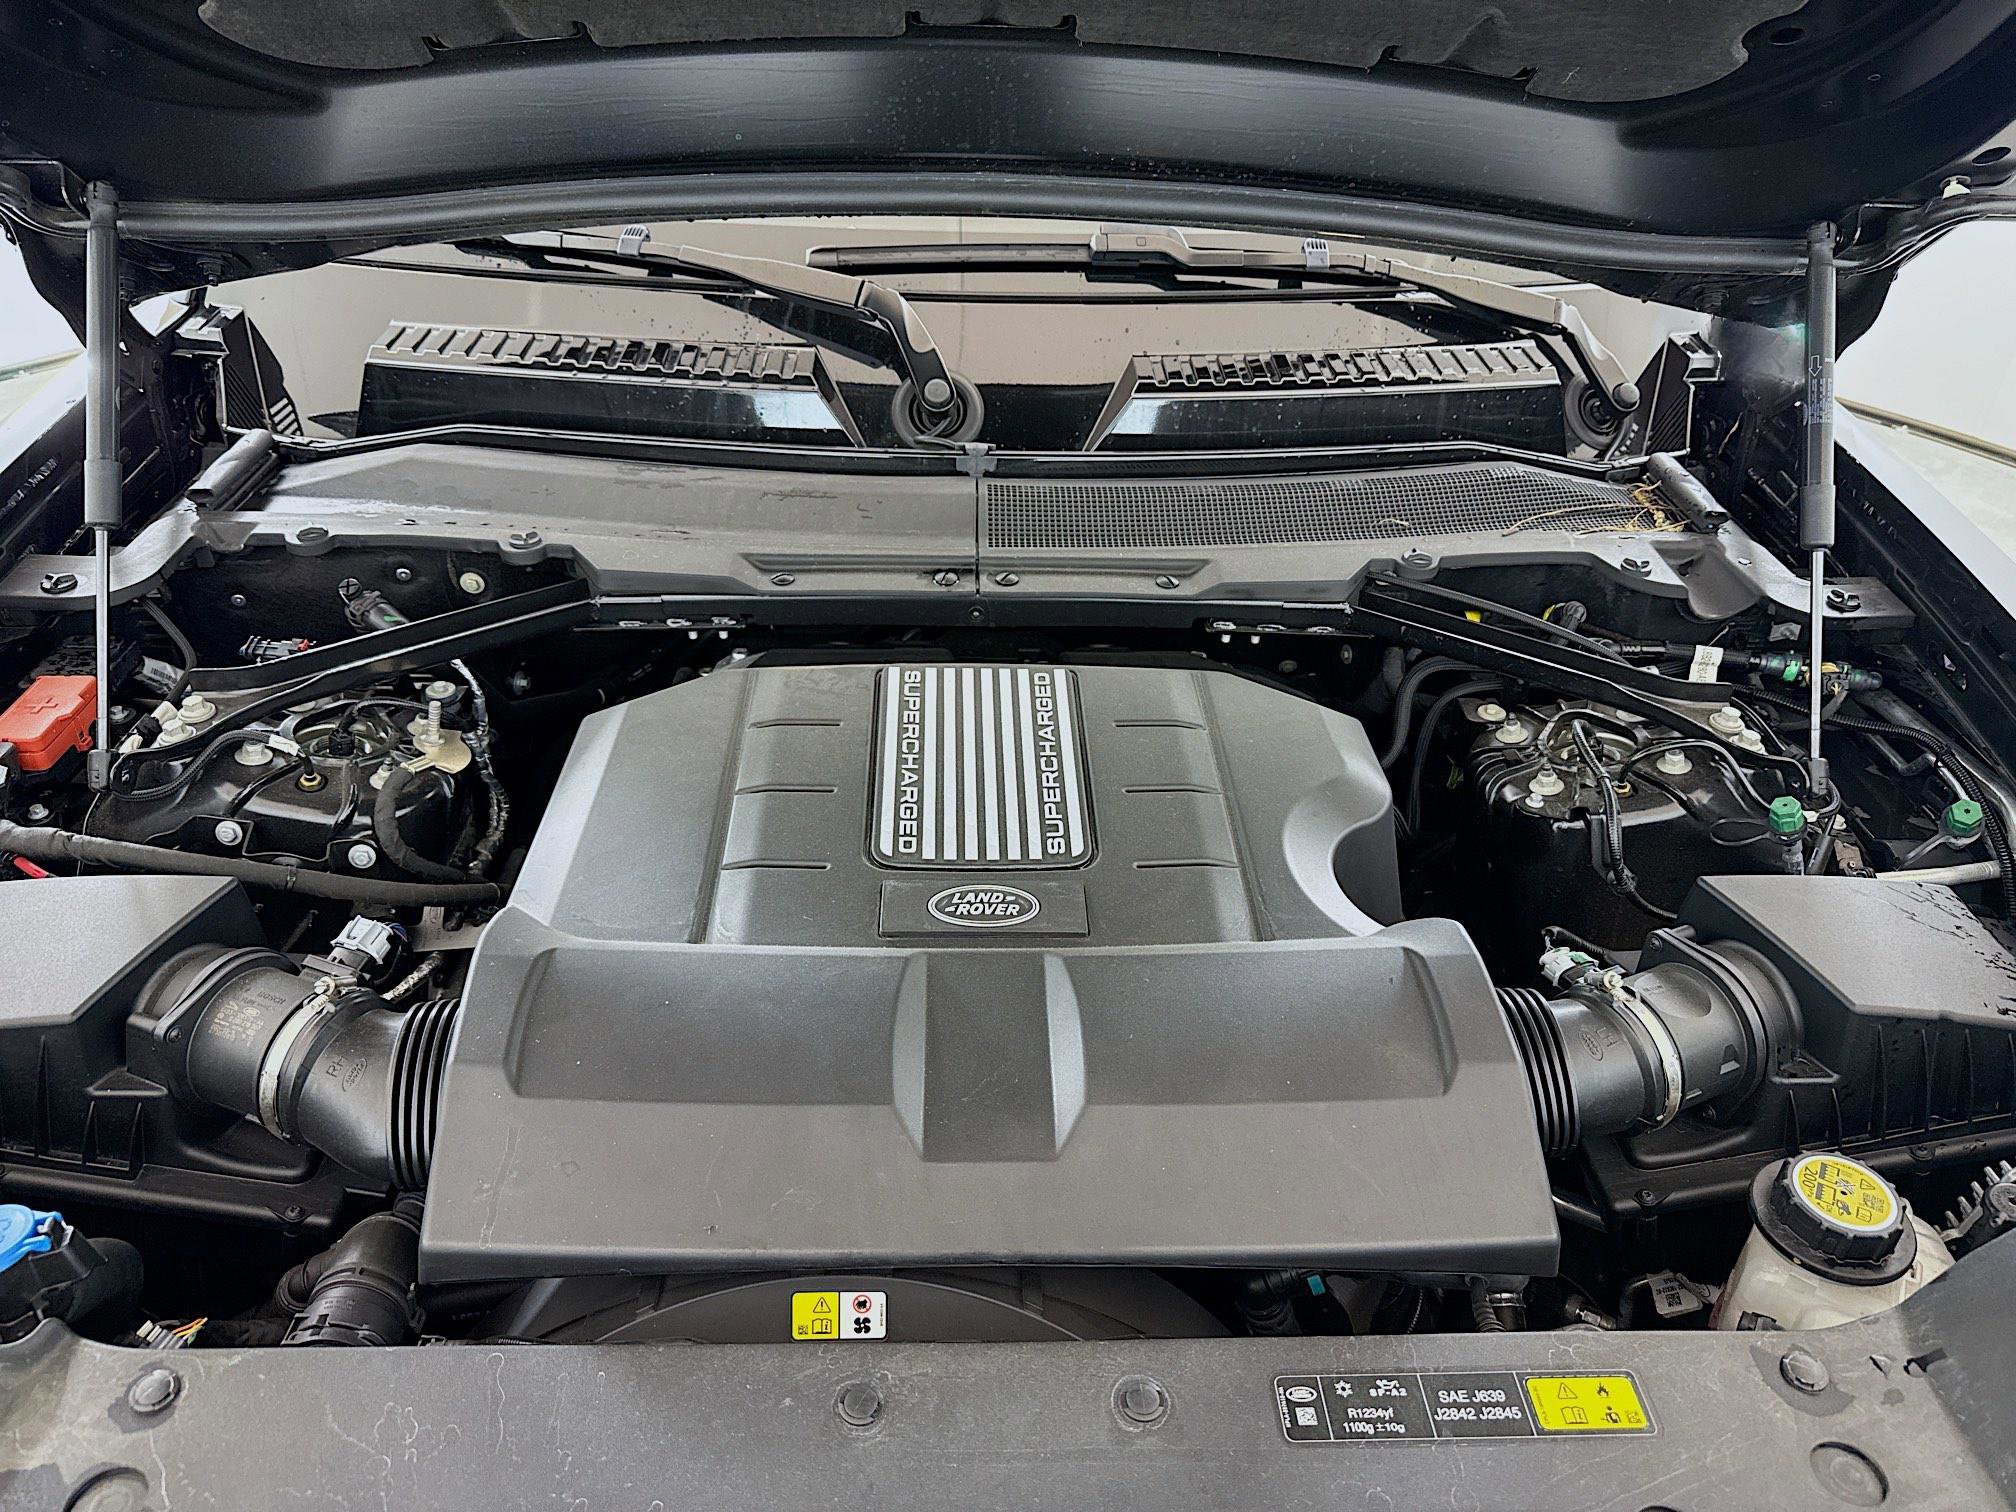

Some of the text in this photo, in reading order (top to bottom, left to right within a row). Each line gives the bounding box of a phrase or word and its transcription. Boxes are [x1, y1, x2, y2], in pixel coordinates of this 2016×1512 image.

[898, 670, 921, 854] SUPERCHARGED
[1033, 672, 1066, 855] SUPERCHARGED
[951, 892, 1004, 903] LAND
[955, 903, 1020, 916] ROVER
[1802, 1166, 1818, 1189] 200
[1438, 1390, 1506, 1403] SAE J639
[1346, 1406, 1394, 1421] R1234yf
[1434, 1406, 1522, 1421] J2842 J2845
[1342, 1421, 1375, 1435] 1100g
